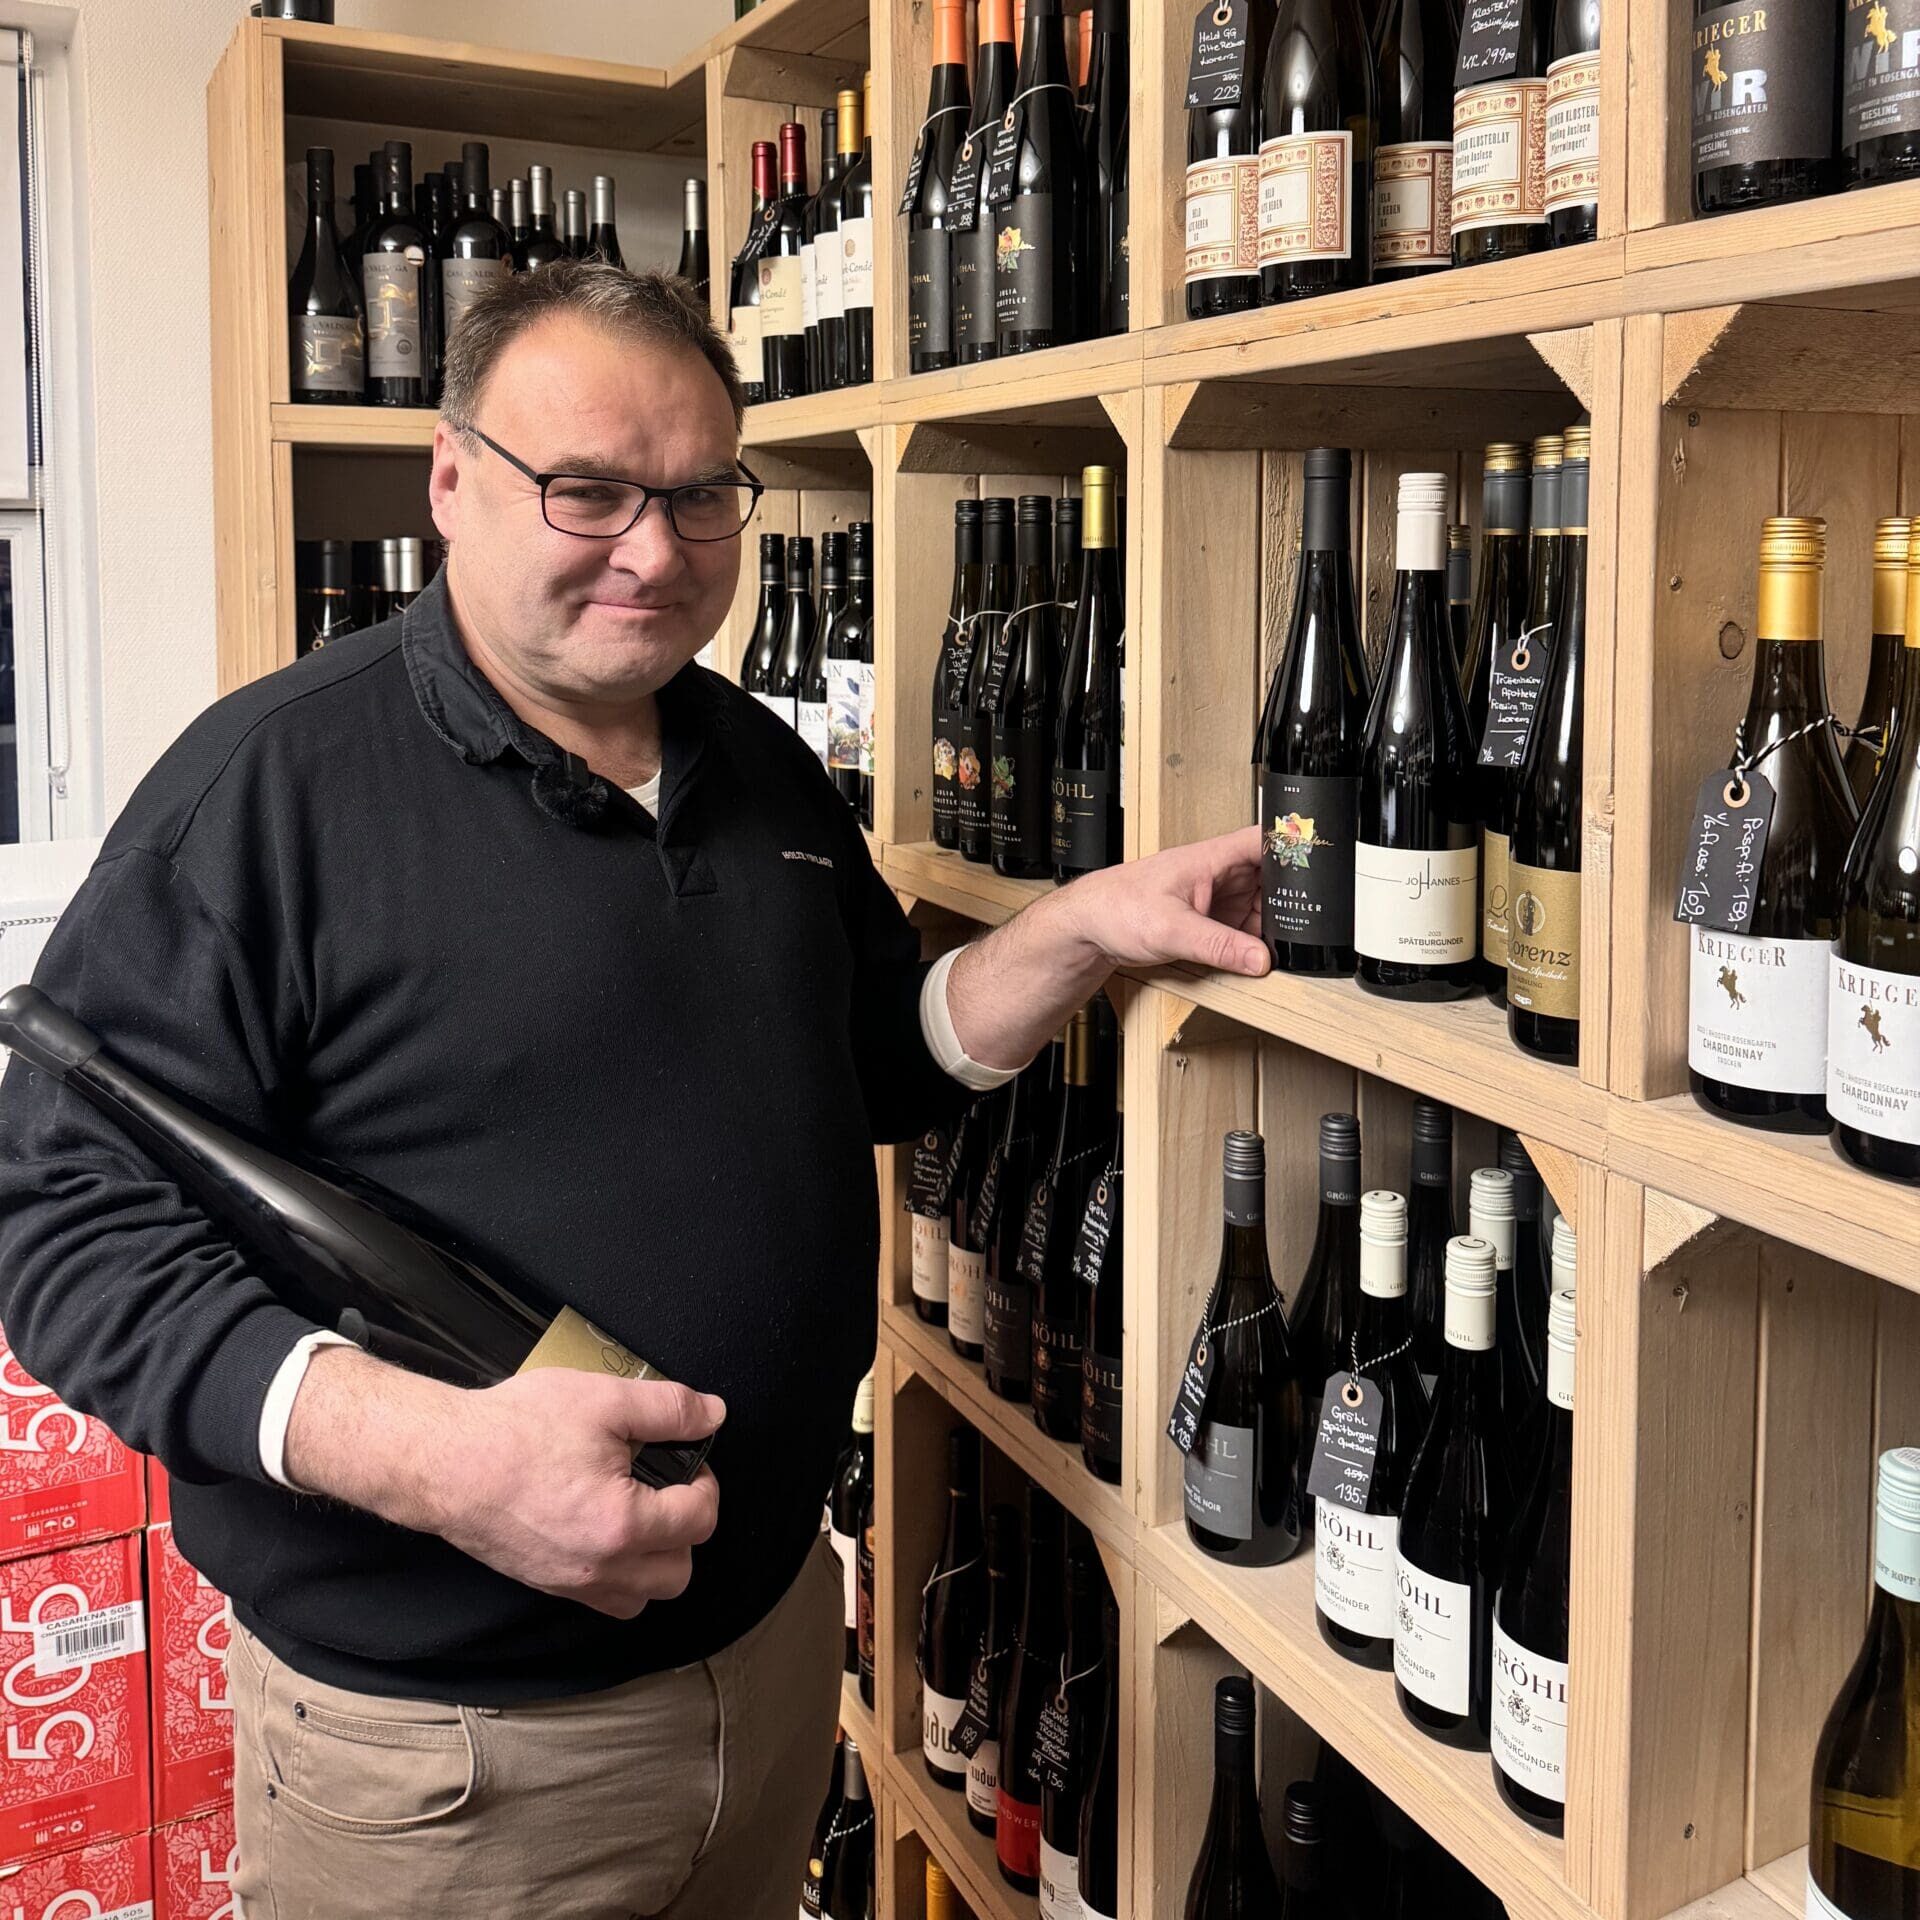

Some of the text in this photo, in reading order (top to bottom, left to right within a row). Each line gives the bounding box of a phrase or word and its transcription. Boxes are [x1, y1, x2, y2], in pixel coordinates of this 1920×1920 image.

[1714, 103, 1768, 120] ROSENGARTEN
[1861, 104, 1898, 122] RIESLING
[1276, 887, 1308, 899] JULIA
[1268, 896, 1322, 913] SCHITTLER
[1275, 914, 1310, 925] RIESLING
[1398, 937, 1464, 946] SPÄTBURGUNDER
[1698, 932, 1787, 967] KRIEGER
[1703, 1038, 1763, 1061] CHARDONNAY
[1732, 1034, 1777, 1049] ROSENGARTEN
[1717, 1056, 1742, 1069] TROCKEN
[1841, 1082, 1908, 1111] CHARDONNAY
[1857, 1103, 1884, 1117] TROCKEN
[1202, 1499, 1222, 1513] NOIR
[46, 1605, 132, 1630] CASARENA 505
